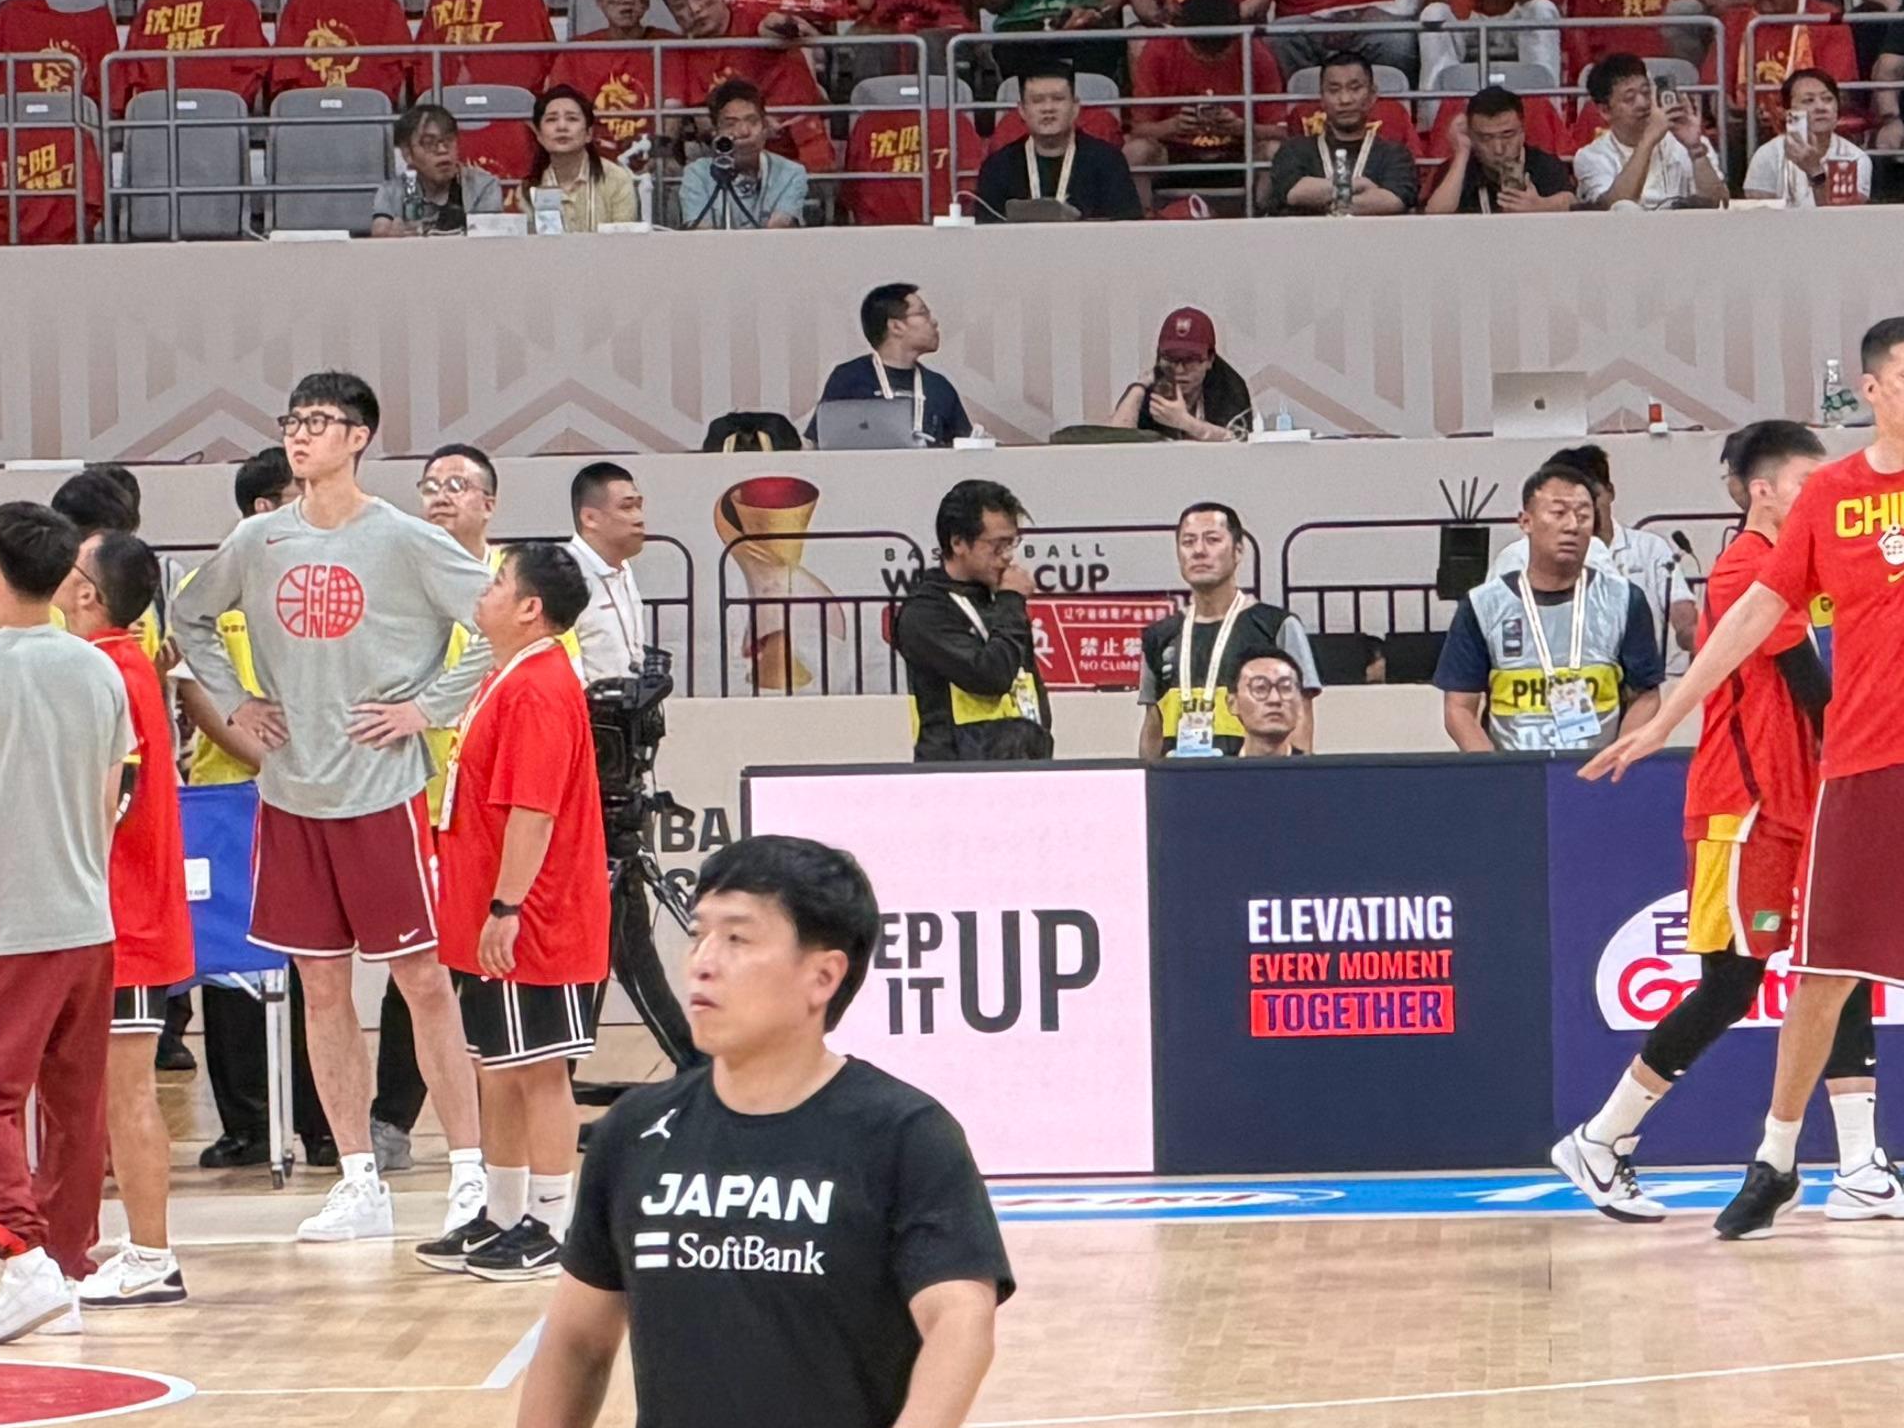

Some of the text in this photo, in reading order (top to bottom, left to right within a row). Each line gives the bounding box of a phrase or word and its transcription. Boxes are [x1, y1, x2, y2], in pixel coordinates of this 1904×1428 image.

[144, 1, 203, 35] 沈阳
[1034, 563, 1110, 592] CUP
[1079, 661, 1140, 672] NO CLIMB
[1080, 636, 1143, 658] 禁止攀
[1248, 894, 1455, 944] ELEVATING
[878, 912, 943, 970] EP
[954, 908, 1101, 1033] UP
[1250, 948, 1454, 984] EVERY MOMENT
[888, 977, 945, 1035] IT
[1263, 992, 1444, 1032] TOGETHER
[640, 1172, 834, 1225] JAPAN
[675, 1231, 826, 1276] SoftBank
